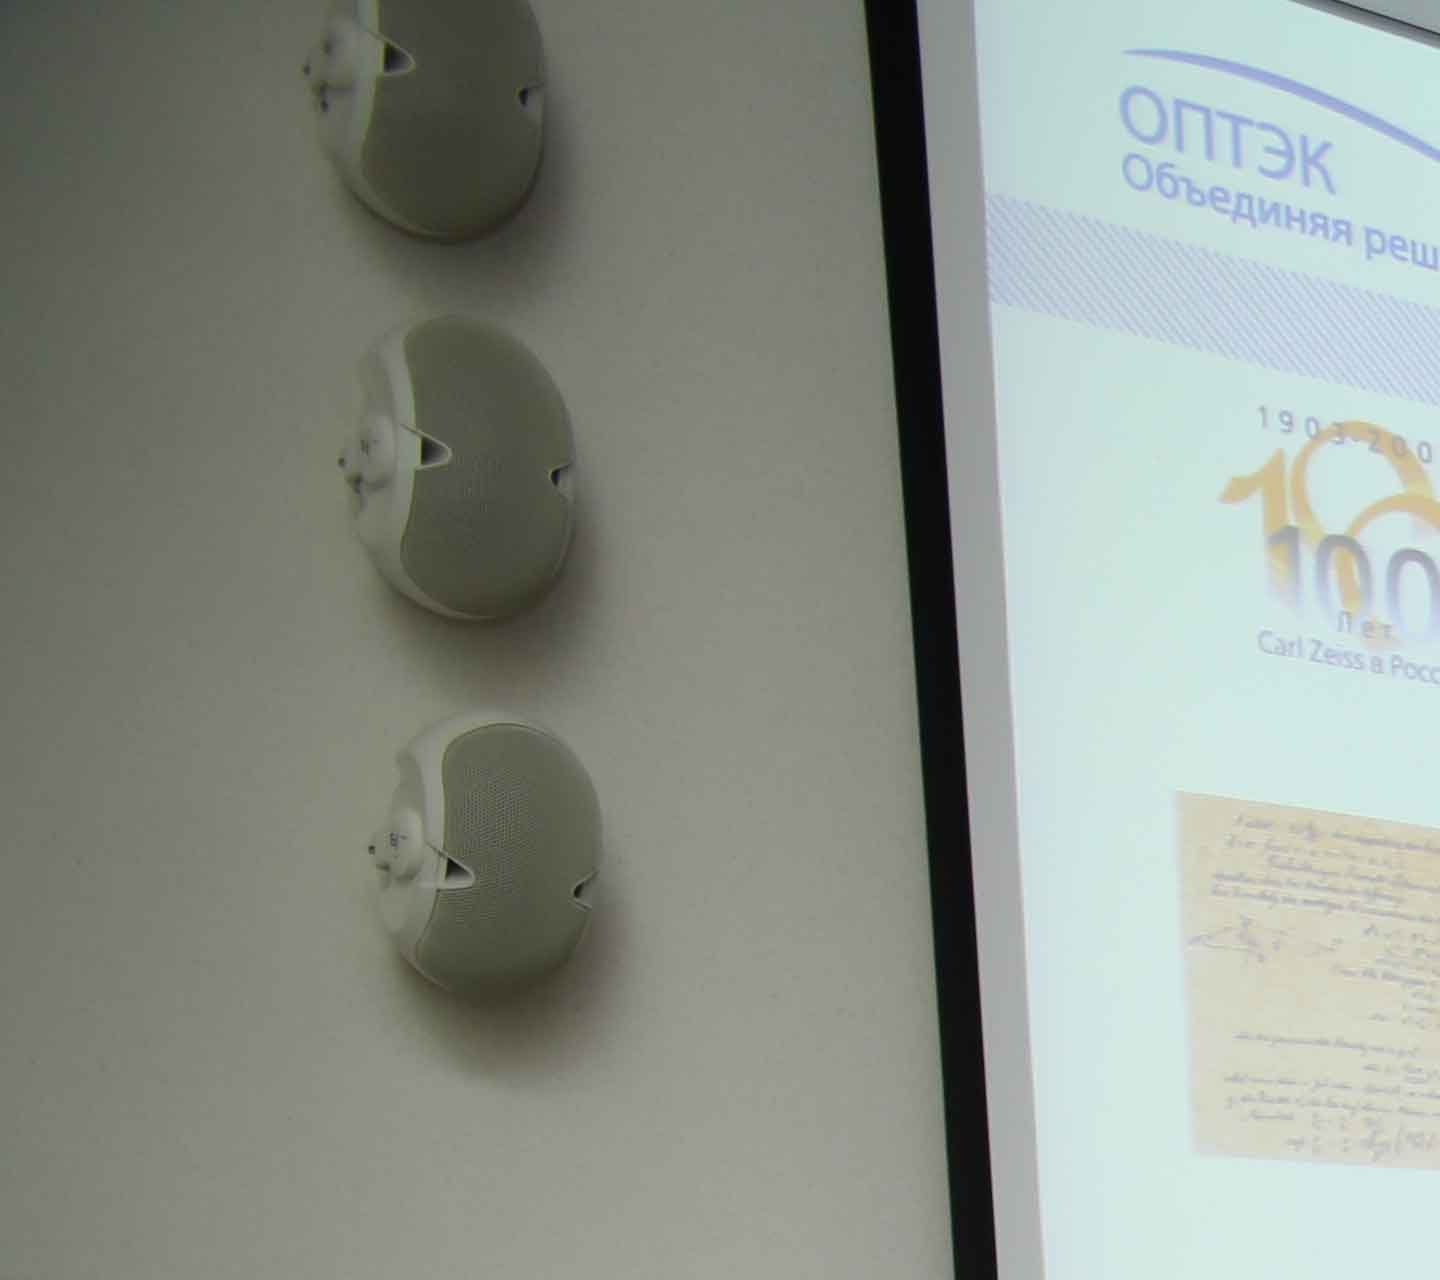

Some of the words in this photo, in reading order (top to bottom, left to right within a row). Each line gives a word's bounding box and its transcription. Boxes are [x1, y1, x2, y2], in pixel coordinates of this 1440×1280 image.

[1118, 84, 1336, 196] ОПТЭК
[1121, 152, 1353, 247] Объединяя
[1257, 629, 1303, 657] Carl
[1309, 638, 1366, 673] Zeiss
[1370, 654, 1385, 675] в
